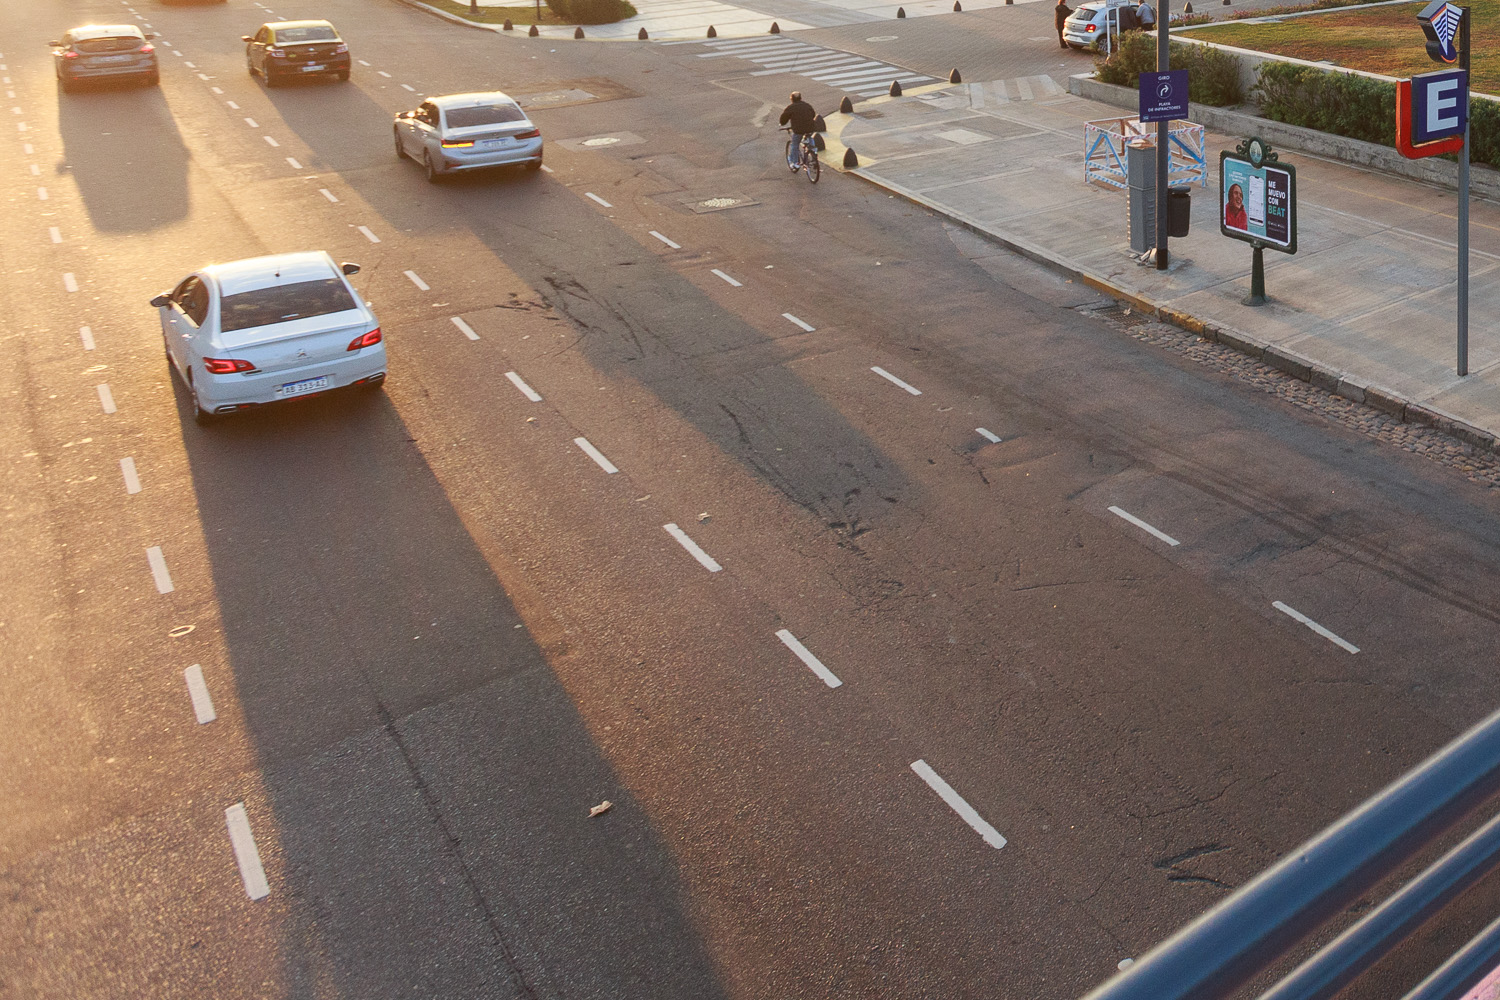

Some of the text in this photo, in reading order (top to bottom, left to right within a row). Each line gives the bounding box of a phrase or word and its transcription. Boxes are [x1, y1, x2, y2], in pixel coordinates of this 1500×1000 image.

[1426, 78, 1459, 133] E
[1268, 180, 1276, 189] ME
[1268, 188, 1286, 200] MUEVO
[1268, 197, 1279, 206] CON
[1268, 205, 1285, 218] BEAT
